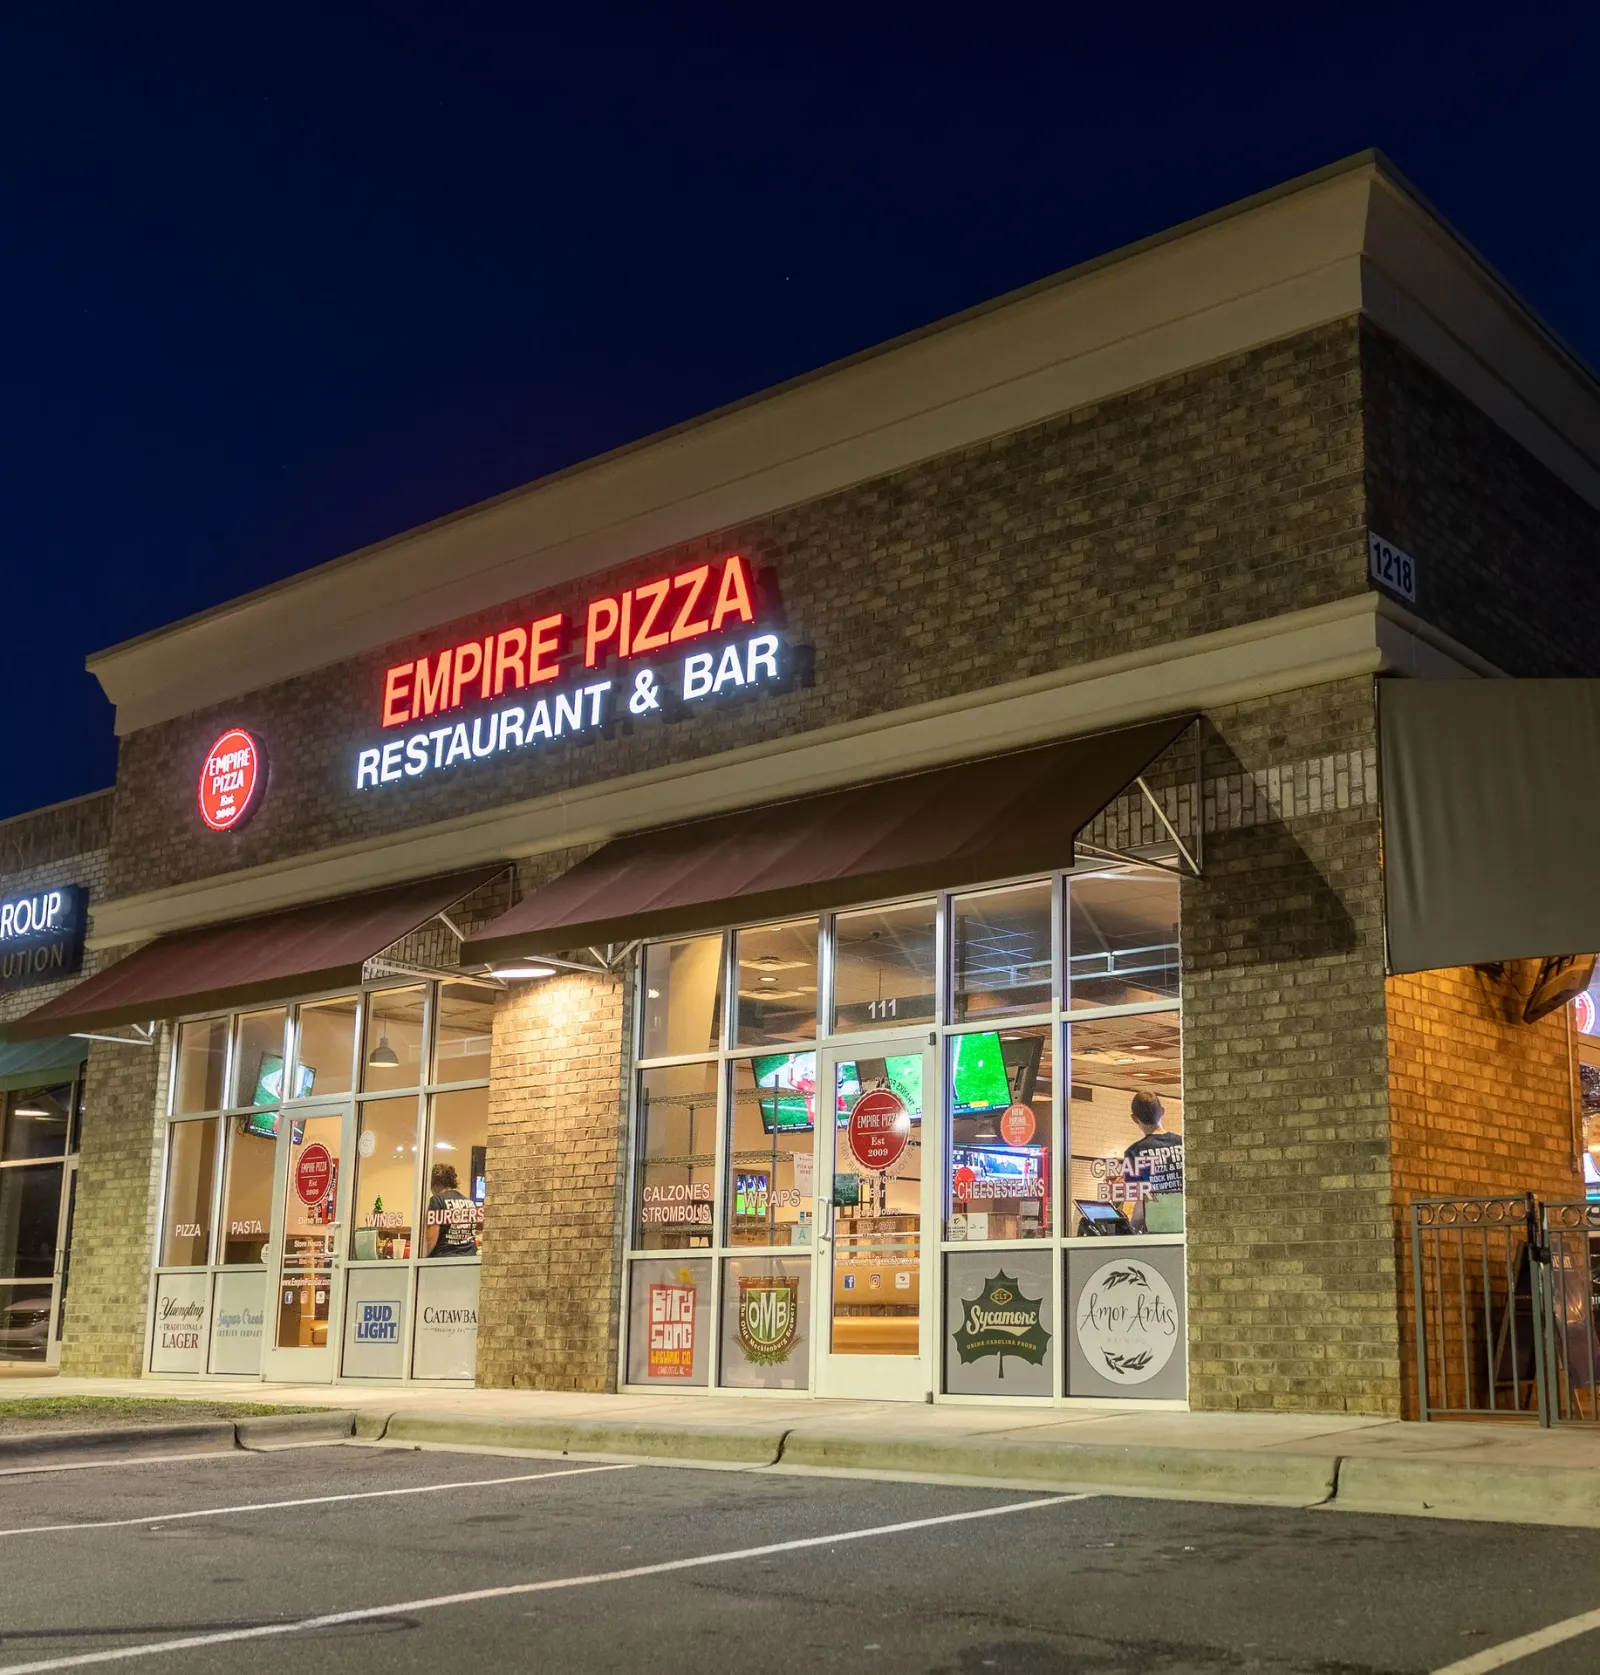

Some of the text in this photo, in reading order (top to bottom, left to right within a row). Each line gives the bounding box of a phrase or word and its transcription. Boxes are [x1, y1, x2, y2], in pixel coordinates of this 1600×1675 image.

[1373, 542, 1412, 593] 1218
[382, 555, 753, 728] EMPIRE PIZZA
[356, 634, 779, 789] RESTAURANT & BAR
[208, 747, 251, 776] EMPIRE
[211, 769, 245, 796] PIZZA
[0, 892, 61, 938] ROUP
[868, 999, 897, 1019] 111
[857, 1114, 880, 1128] EMPIRE
[871, 1136, 885, 1146] Est
[867, 1148, 888, 1157] 2009
[300, 1161, 327, 1174] EMPIRE PIZZA
[1091, 1157, 1159, 1178] CRAFT
[1149, 1175, 1165, 1183] ROCK
[643, 1183, 710, 1202] CALZONES
[743, 1188, 801, 1208] WRAPS
[957, 1178, 1045, 1200] CHEESESTEAKS
[1098, 1182, 1154, 1203] BEER
[366, 1212, 404, 1228] WINGS
[427, 1207, 485, 1225] BURGERS
[641, 1204, 710, 1223] STROMBOLIS
[175, 1223, 201, 1237] PIZZA
[231, 1220, 262, 1235] PASTA
[159, 1296, 205, 1321] Yuengling
[363, 1305, 392, 1322] BUD
[423, 1306, 477, 1324] CATAWBA
[748, 1292, 787, 1339] OMB
[1080, 1292, 1176, 1336] Amor Artis
[163, 1323, 199, 1331] TRADITIONAL
[740, 1320, 749, 1340] Olde
[749, 1338, 788, 1352] Mecklenburg
[785, 1302, 796, 1338] Brewery
[966, 1304, 1038, 1335] Sycamore
[357, 1322, 397, 1339] LIGHT
[161, 1333, 199, 1348] LAGER
[966, 1341, 985, 1350] DRINK
[1016, 1340, 1037, 1350] PROUD
